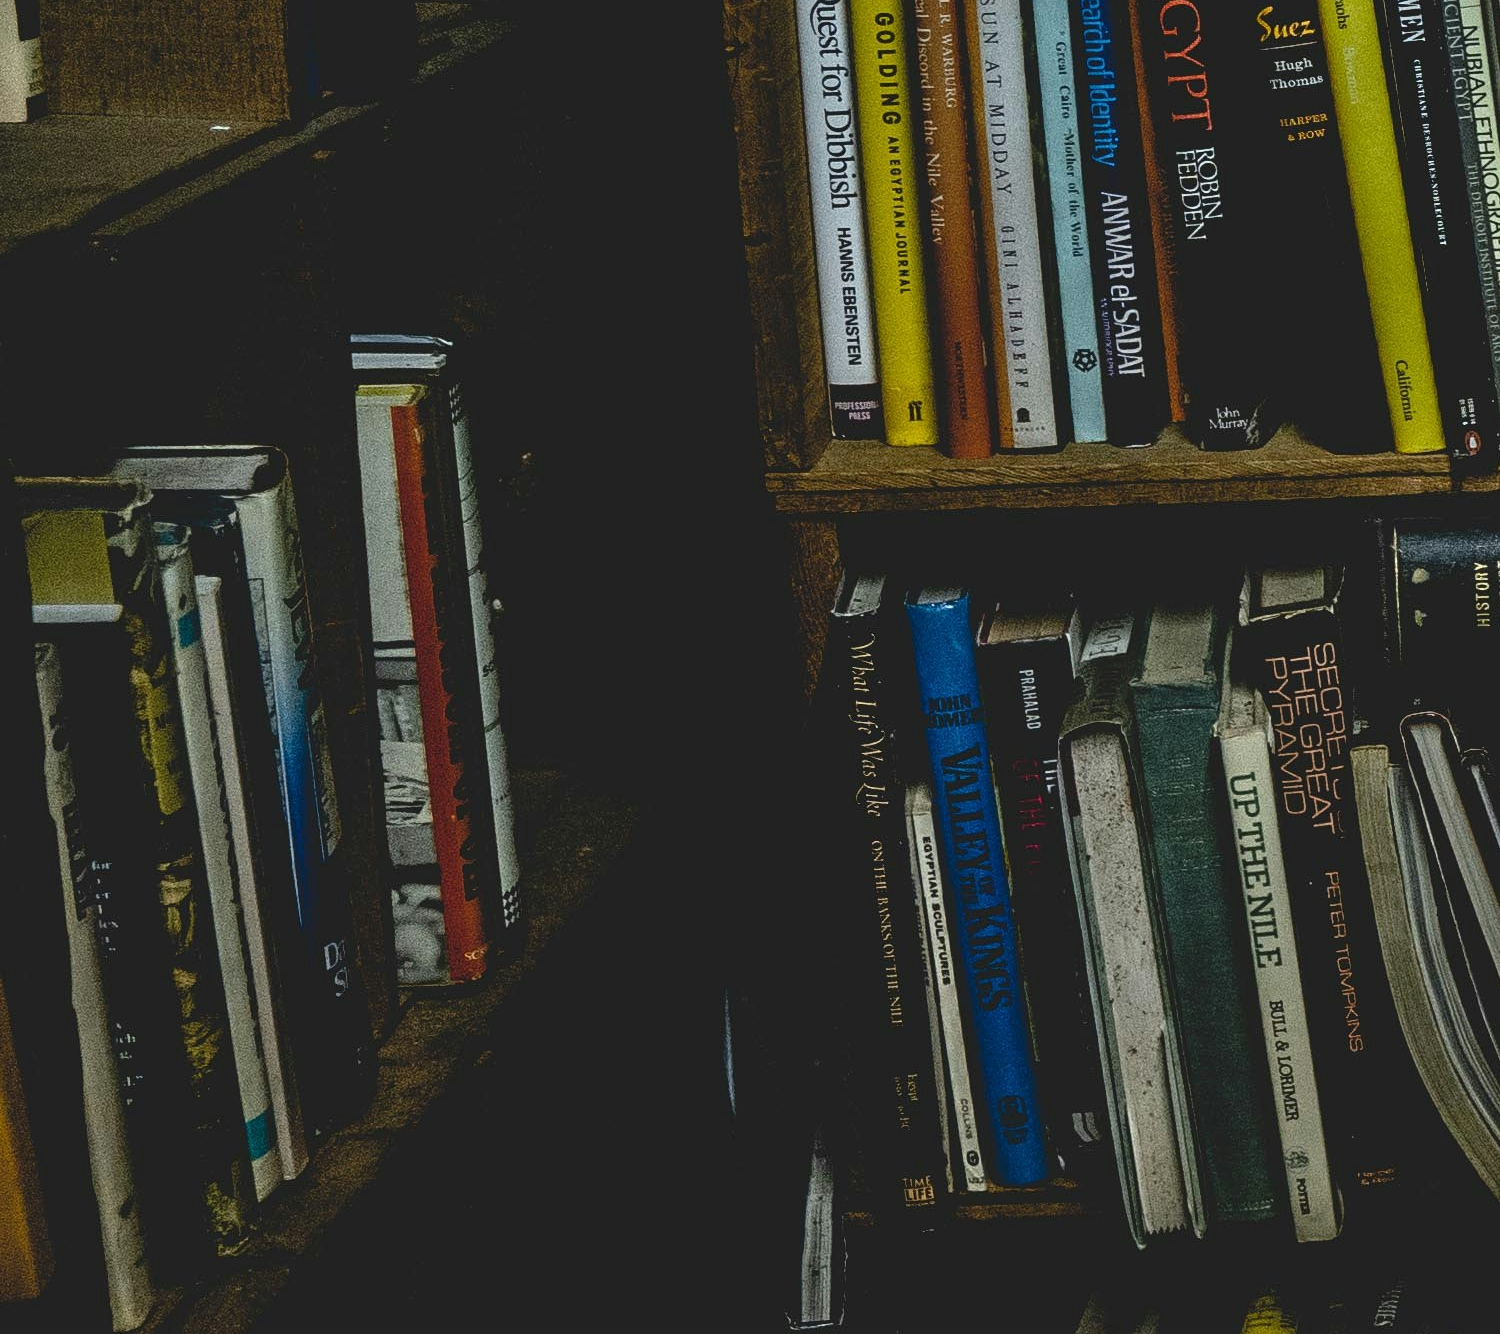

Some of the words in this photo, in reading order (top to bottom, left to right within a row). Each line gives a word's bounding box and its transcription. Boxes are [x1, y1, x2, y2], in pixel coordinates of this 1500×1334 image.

[1256, 6, 1315, 44] Suez
[820, 64, 844, 103] for
[875, 11, 901, 125] GOLDING
[1269, 72, 1324, 91] Thomas
[1274, 57, 1314, 73] Hugh
[823, 108, 852, 211] Dibbish
[837, 227, 855, 282] HANNS
[1100, 190, 1134, 279] ANWAR
[842, 286, 863, 366] EBENSTEN
[1109, 283, 1146, 378] el-SADAT
[1227, 771, 1258, 819] UP
[1238, 821, 1270, 890] THE
[1249, 892, 1282, 969] NILE
